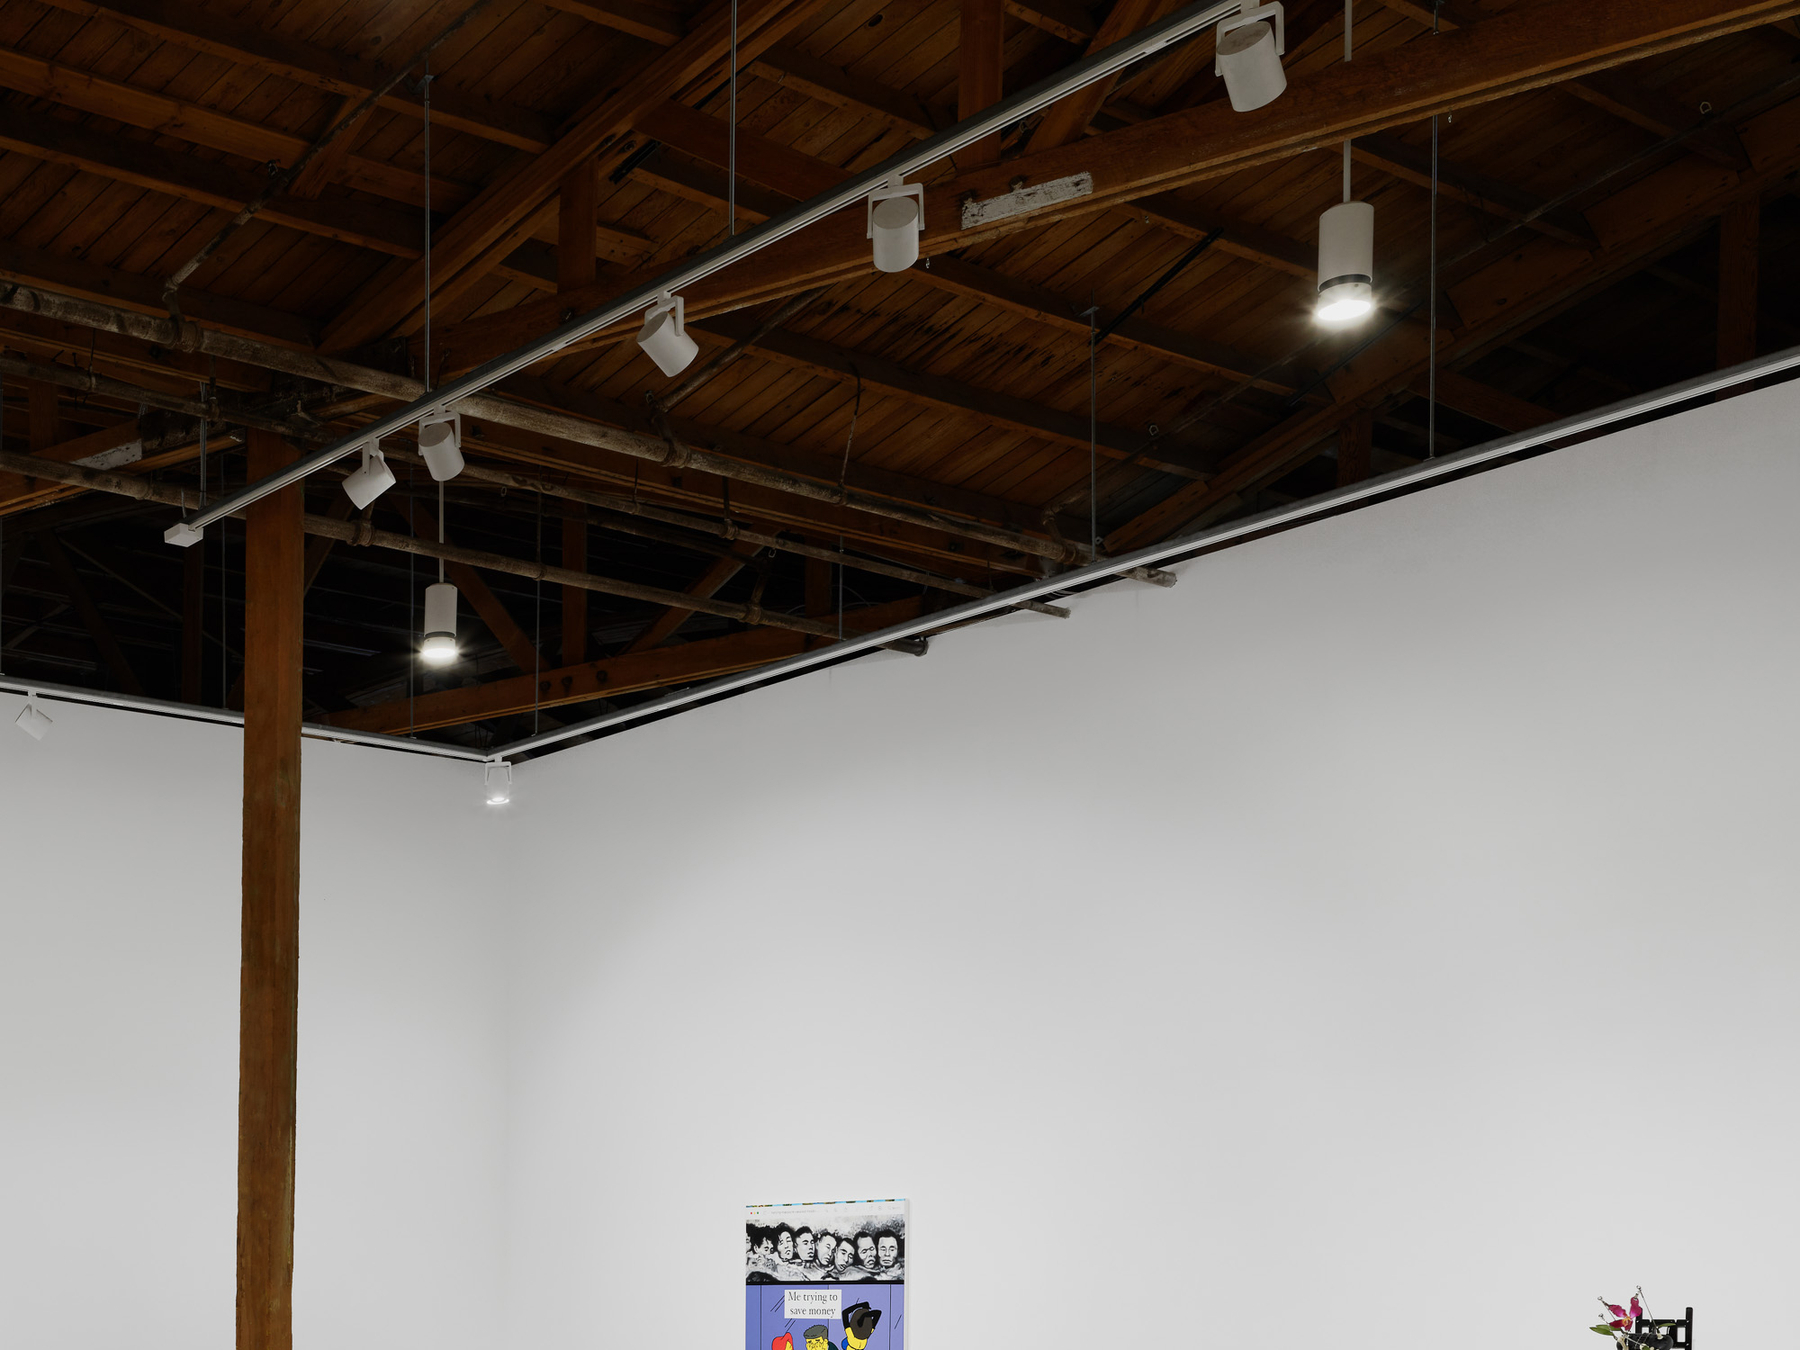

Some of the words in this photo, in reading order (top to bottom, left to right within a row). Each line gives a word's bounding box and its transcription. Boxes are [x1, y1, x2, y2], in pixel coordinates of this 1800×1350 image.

[788, 1292, 801, 1301] Me
[803, 1292, 827, 1304] trying
[808, 1308, 836, 1318] money
